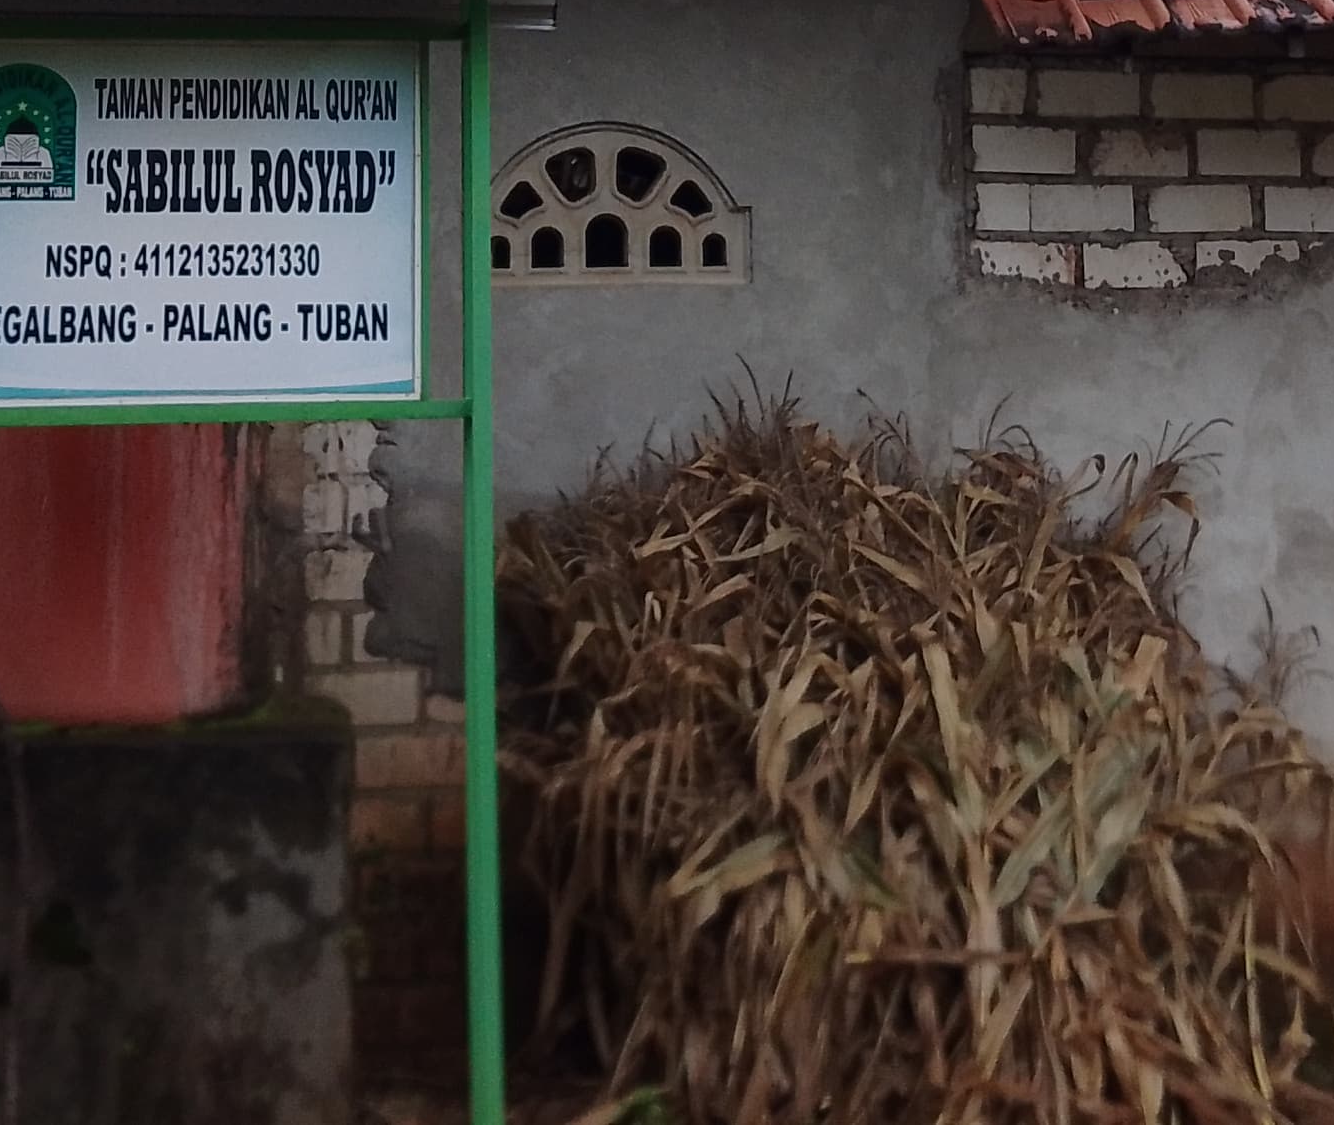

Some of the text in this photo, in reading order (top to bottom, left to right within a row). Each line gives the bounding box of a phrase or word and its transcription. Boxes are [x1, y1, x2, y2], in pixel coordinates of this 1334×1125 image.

[94, 76, 397, 124] TAMAN PENDIDIKAN AL QUR'AN
[45, 245, 113, 279] NSPQ
[133, 244, 321, 278] 4112135231330
[163, 304, 273, 343] PALANG
[297, 303, 389, 343] TUBAN
